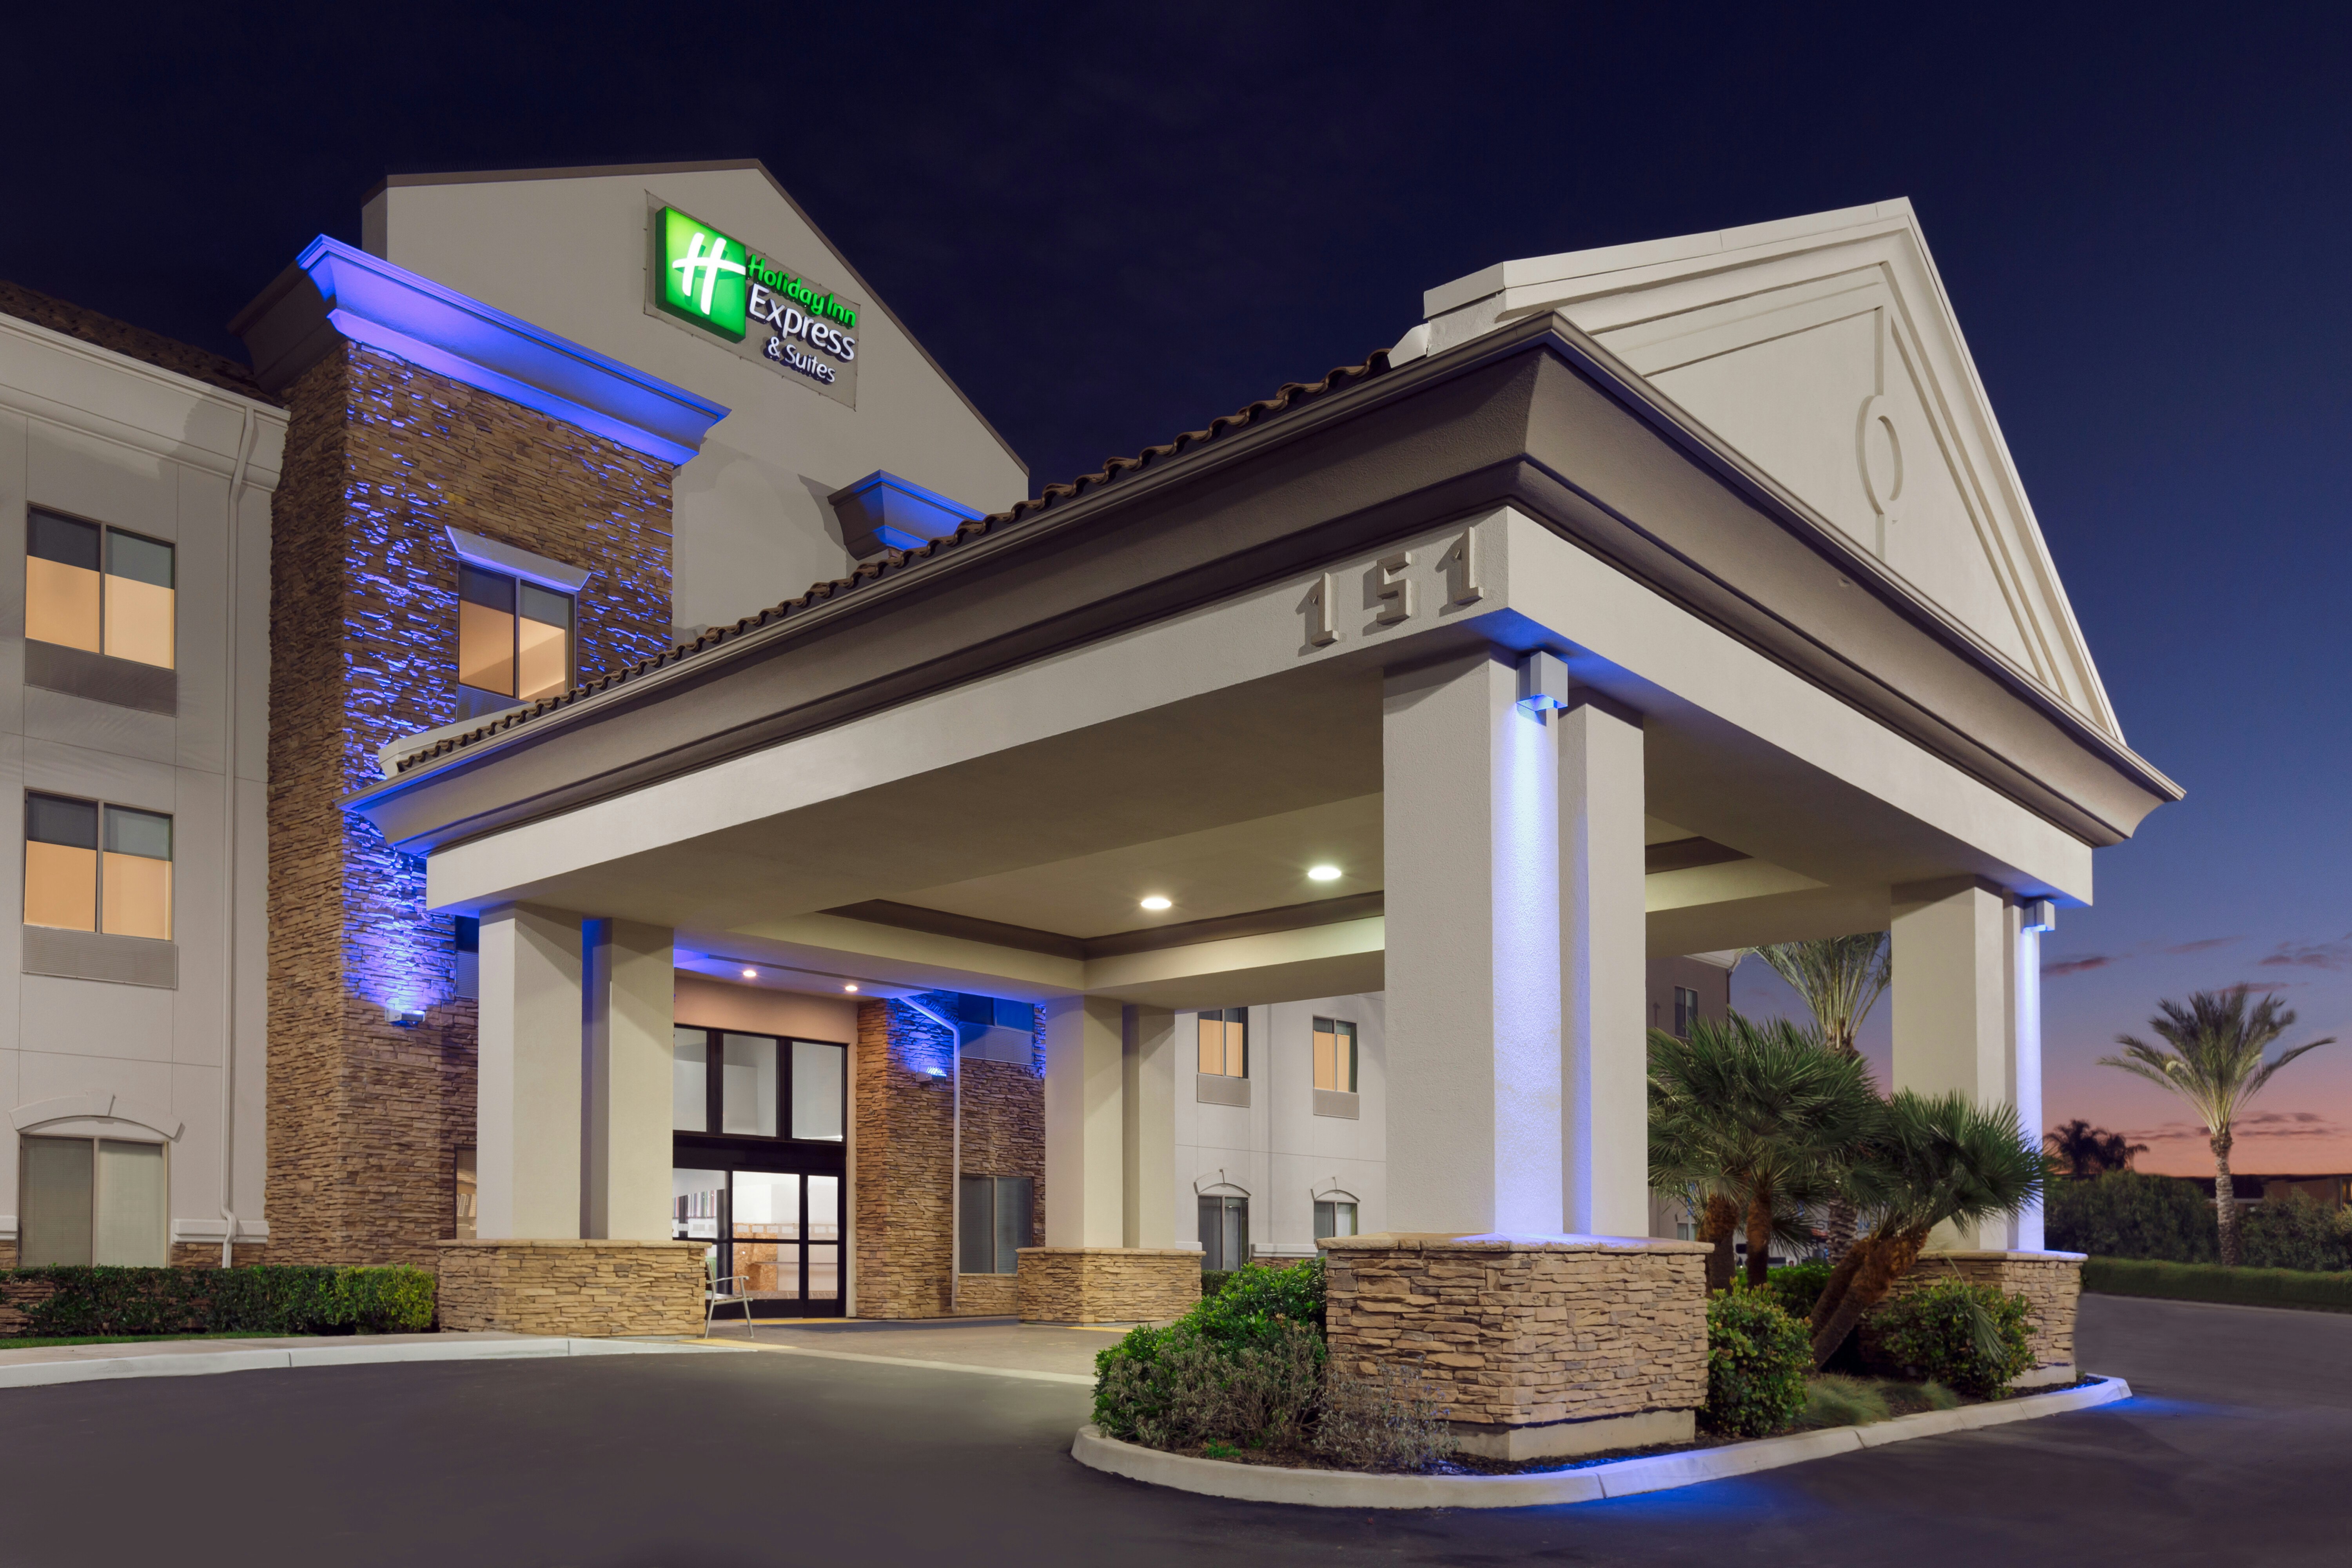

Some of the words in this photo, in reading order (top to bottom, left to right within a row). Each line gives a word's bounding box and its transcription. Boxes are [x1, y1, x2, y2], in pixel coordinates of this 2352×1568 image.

[748, 254, 824, 315] Holiday
[825, 294, 856, 327] Inn
[749, 283, 855, 361] Express
[768, 336, 781, 357] &
[785, 344, 836, 383] Suites
[1308, 527, 1485, 647] 151
